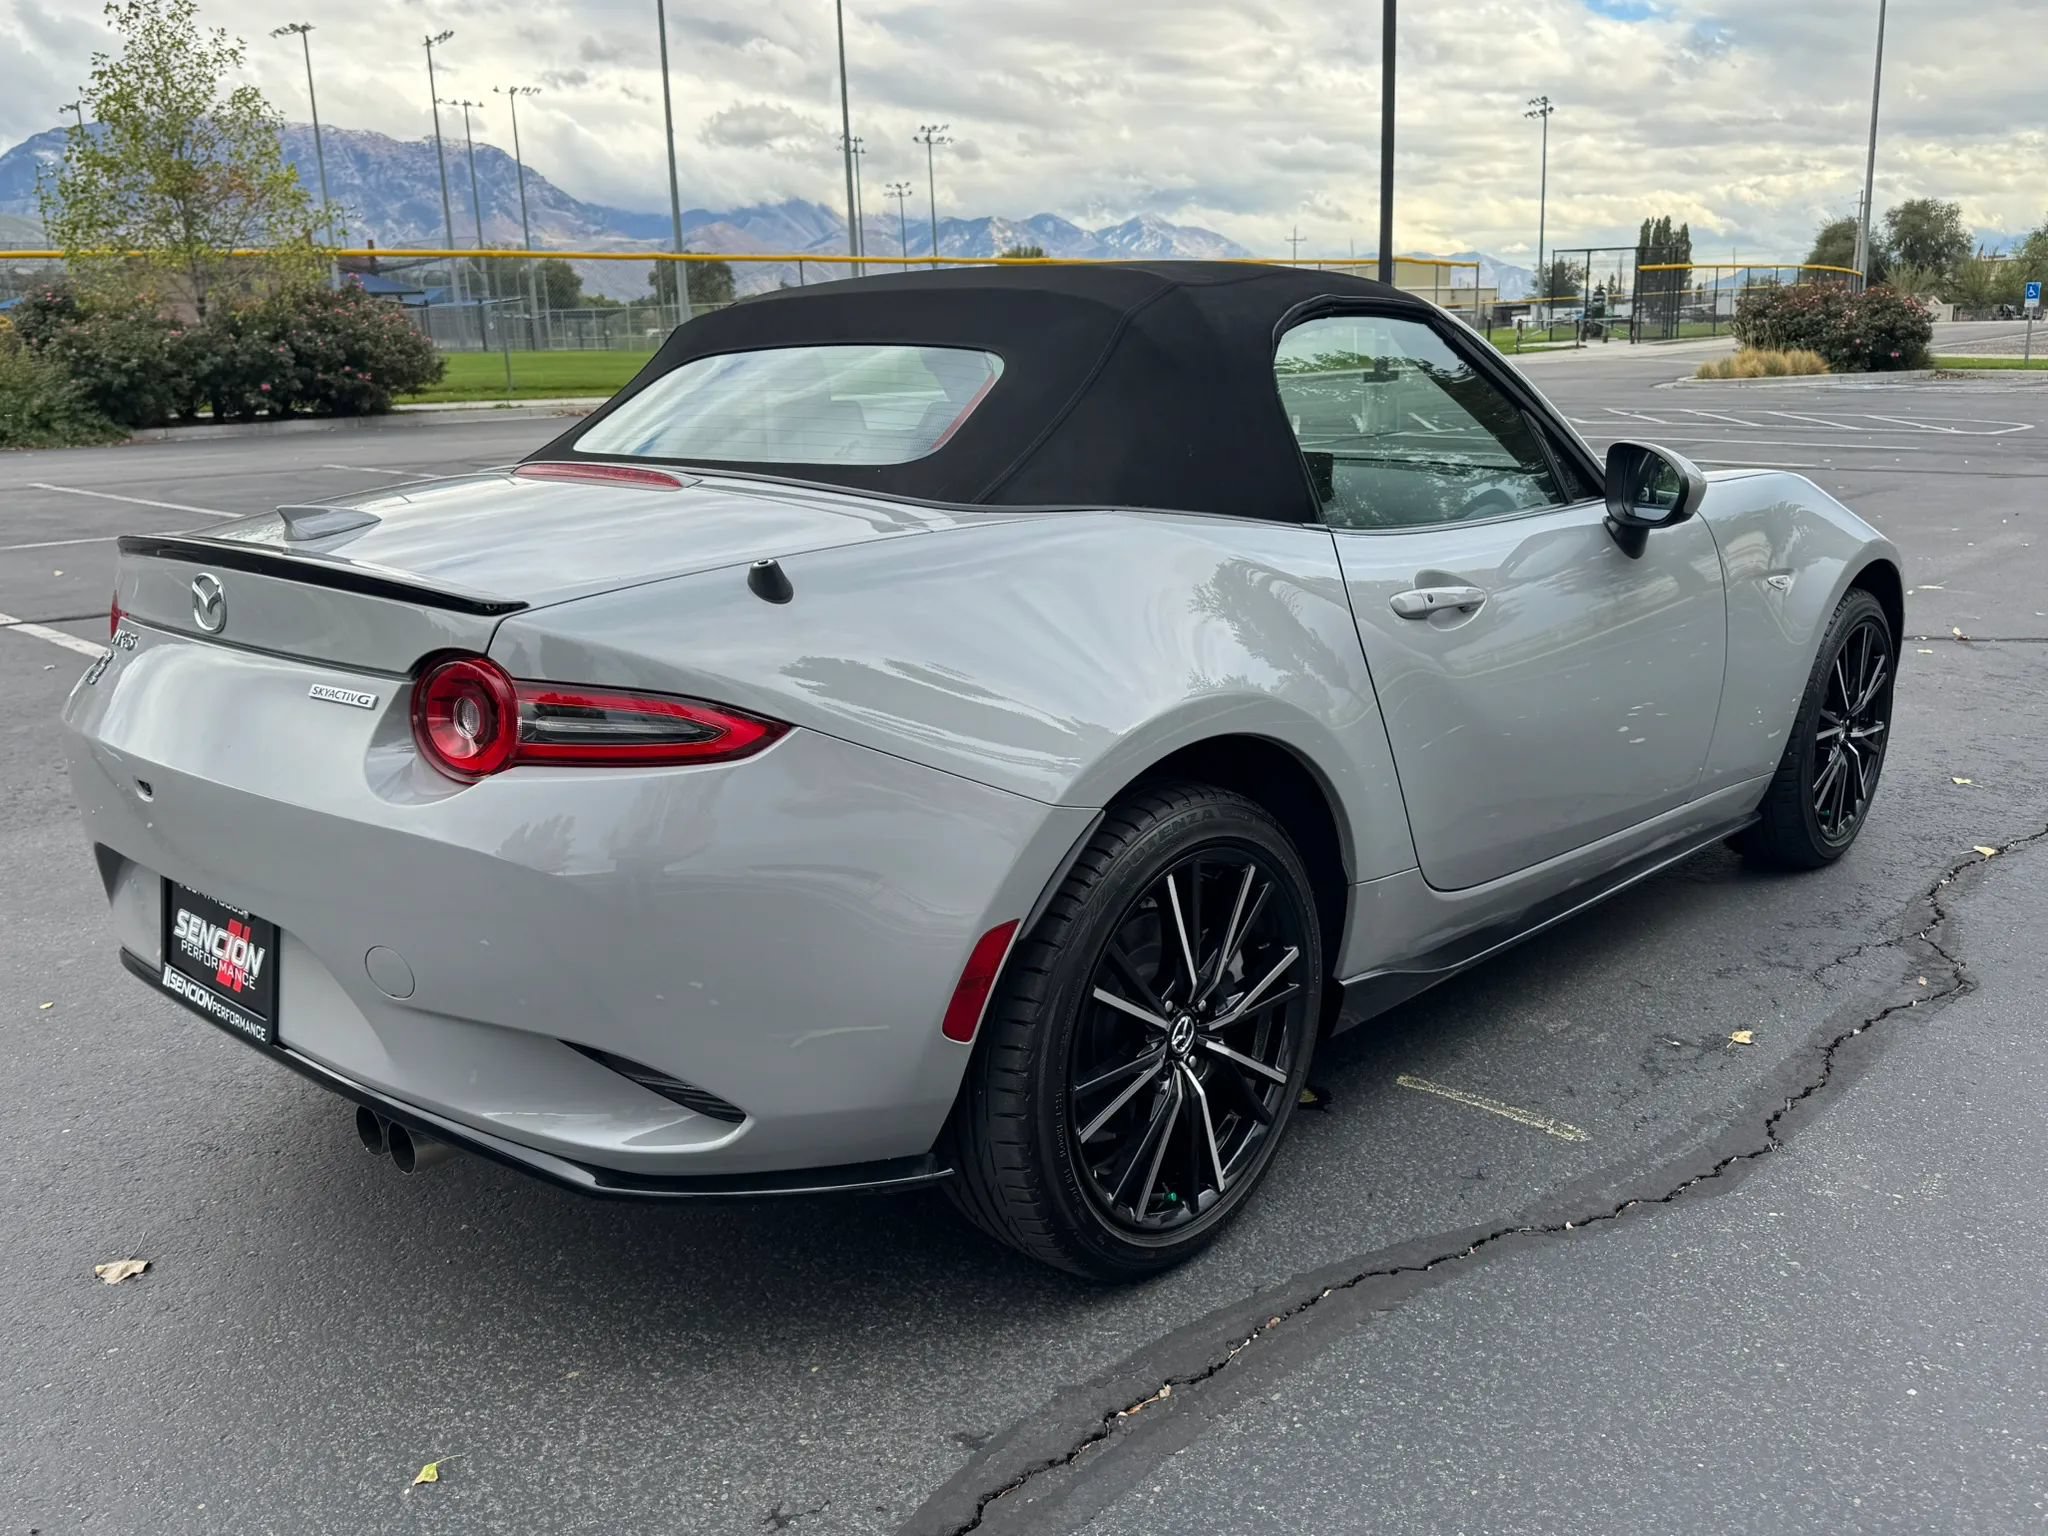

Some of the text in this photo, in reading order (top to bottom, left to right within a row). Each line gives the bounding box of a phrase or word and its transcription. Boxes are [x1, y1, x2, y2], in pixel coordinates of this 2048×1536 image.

[173, 908, 266, 978] SENCION
[181, 939, 256, 991] PERFORMANCE
[168, 972, 267, 1042] SENCION PERFORMANCE
